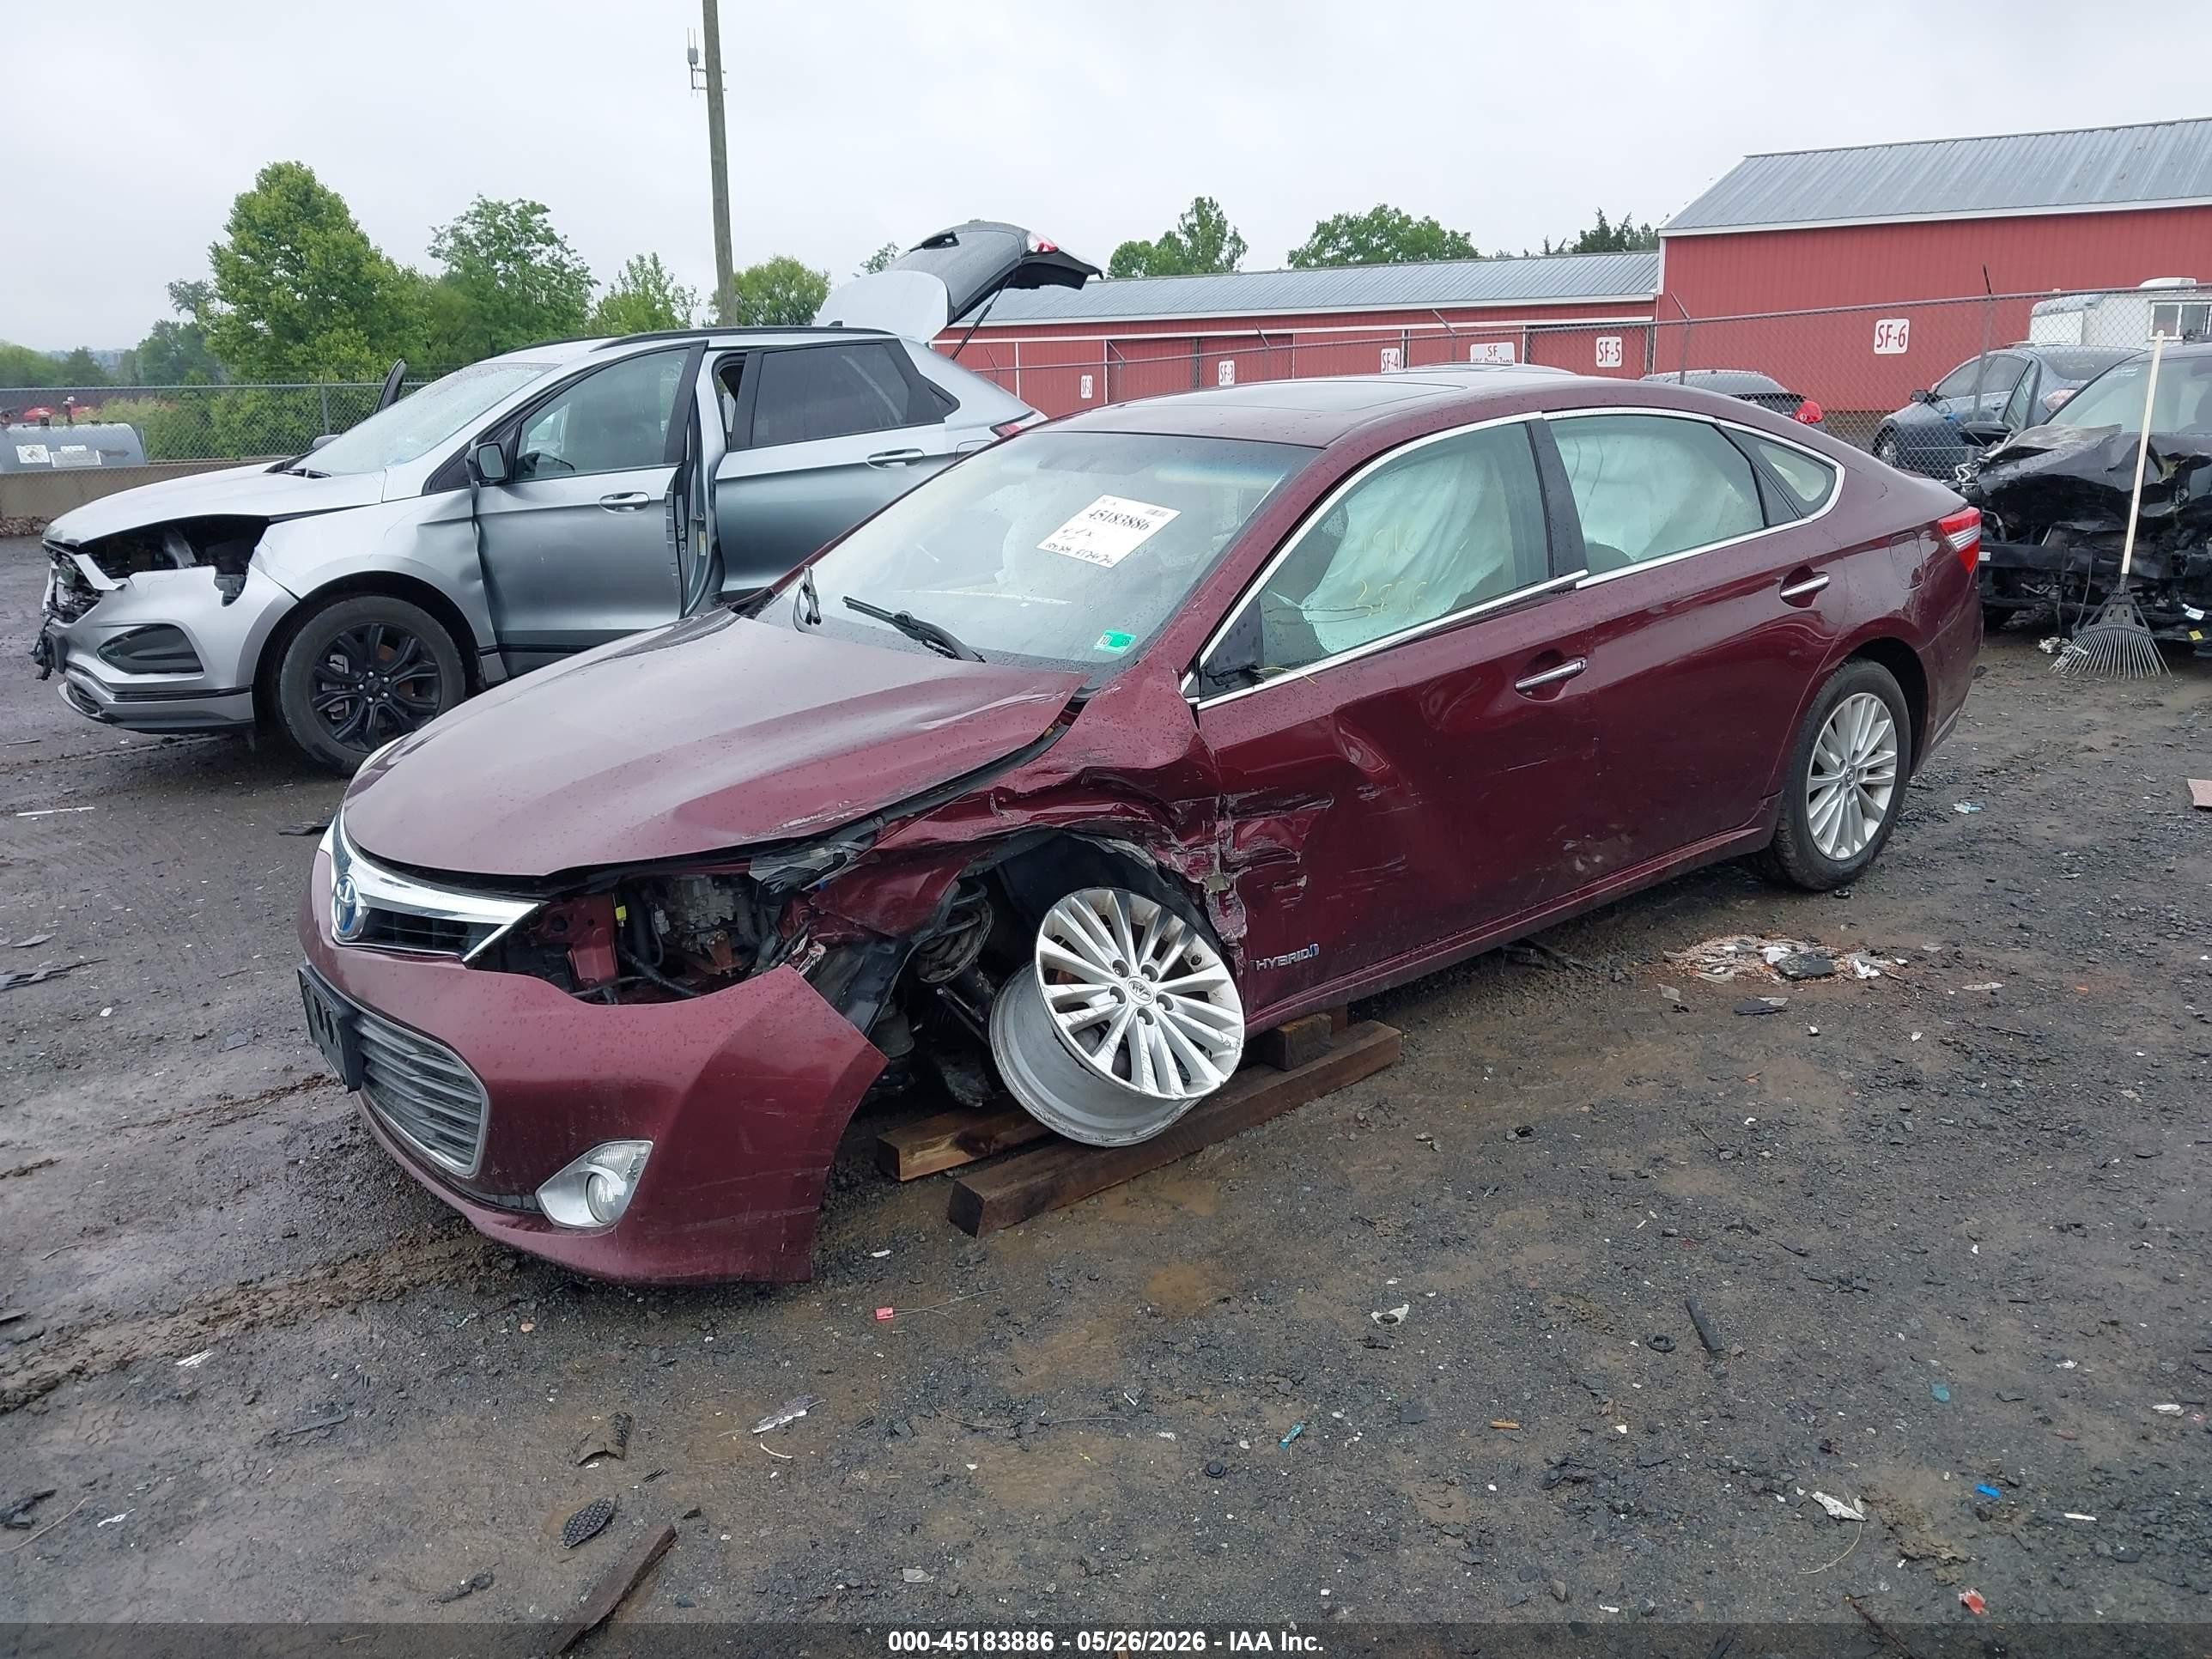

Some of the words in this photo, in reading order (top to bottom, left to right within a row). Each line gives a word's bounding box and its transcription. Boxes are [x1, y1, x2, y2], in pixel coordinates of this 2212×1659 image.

[1876, 324, 1906, 348] SF-6
[1487, 344, 1498, 357] SF
[1598, 341, 1620, 362] SF-5
[1219, 362, 1234, 382] SF-3
[1382, 352, 1399, 372] SF-4
[1081, 378, 1092, 395] SF-2
[1088, 508, 1152, 531] 45183886
[1099, 636, 1111, 646] 10
[1255, 948, 1312, 970] HYBRID
